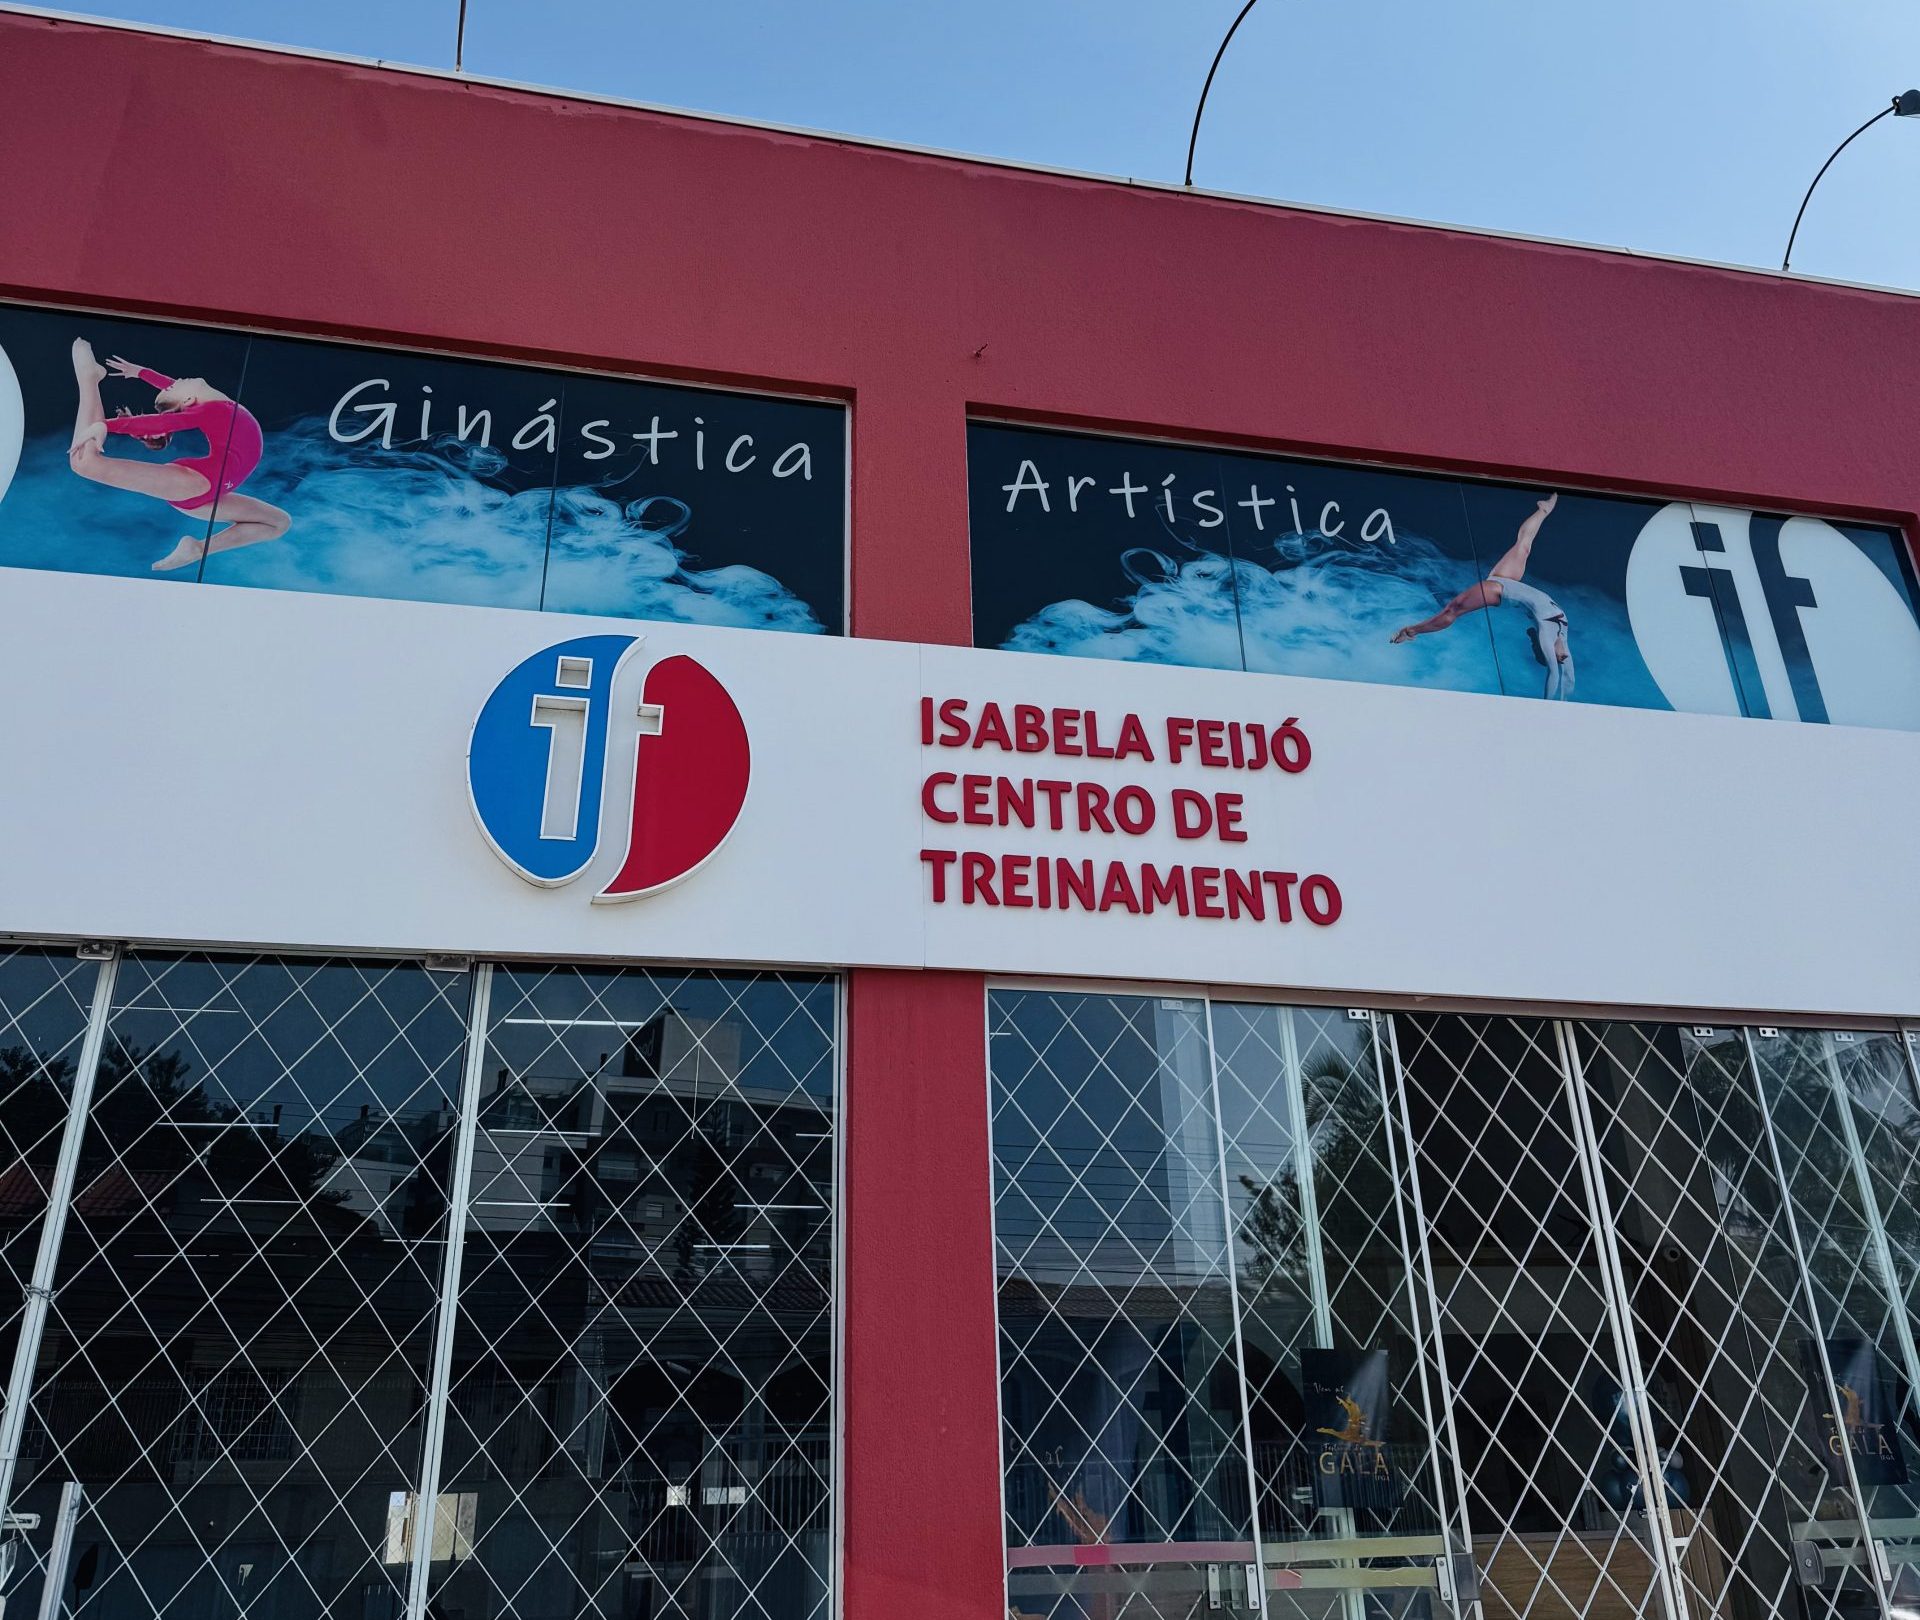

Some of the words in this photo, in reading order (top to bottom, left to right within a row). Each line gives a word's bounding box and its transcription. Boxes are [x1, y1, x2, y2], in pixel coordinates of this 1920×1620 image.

[327, 378, 814, 481] Ginástica
[1001, 458, 1397, 544] Artística
[920, 696, 1155, 762] ISABELA
[1166, 716, 1312, 774] FEIJÓ
[921, 771, 1156, 835] CENTRO
[1172, 788, 1249, 842] DE
[919, 849, 1343, 926] TREINAMENTO
[1319, 1451, 1389, 1475] GALA
[1829, 1434, 1893, 1457] GALA
